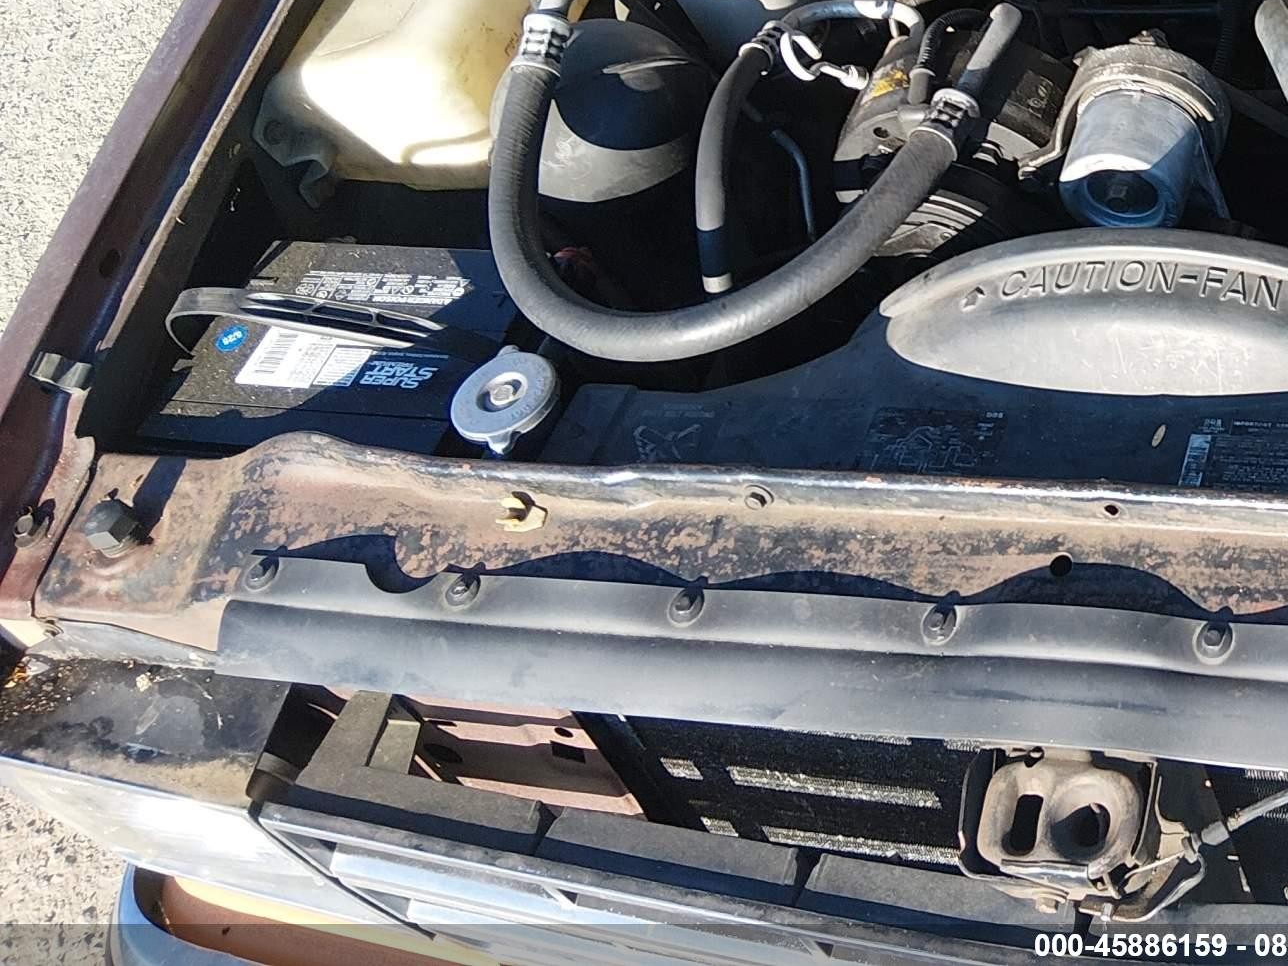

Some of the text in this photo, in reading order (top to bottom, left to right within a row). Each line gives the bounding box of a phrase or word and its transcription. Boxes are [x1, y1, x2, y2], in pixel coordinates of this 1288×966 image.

[1000, 260, 1283, 311] CAUTION-FAN
[365, 366, 440, 380] START
[360, 374, 421, 389] SUPER
